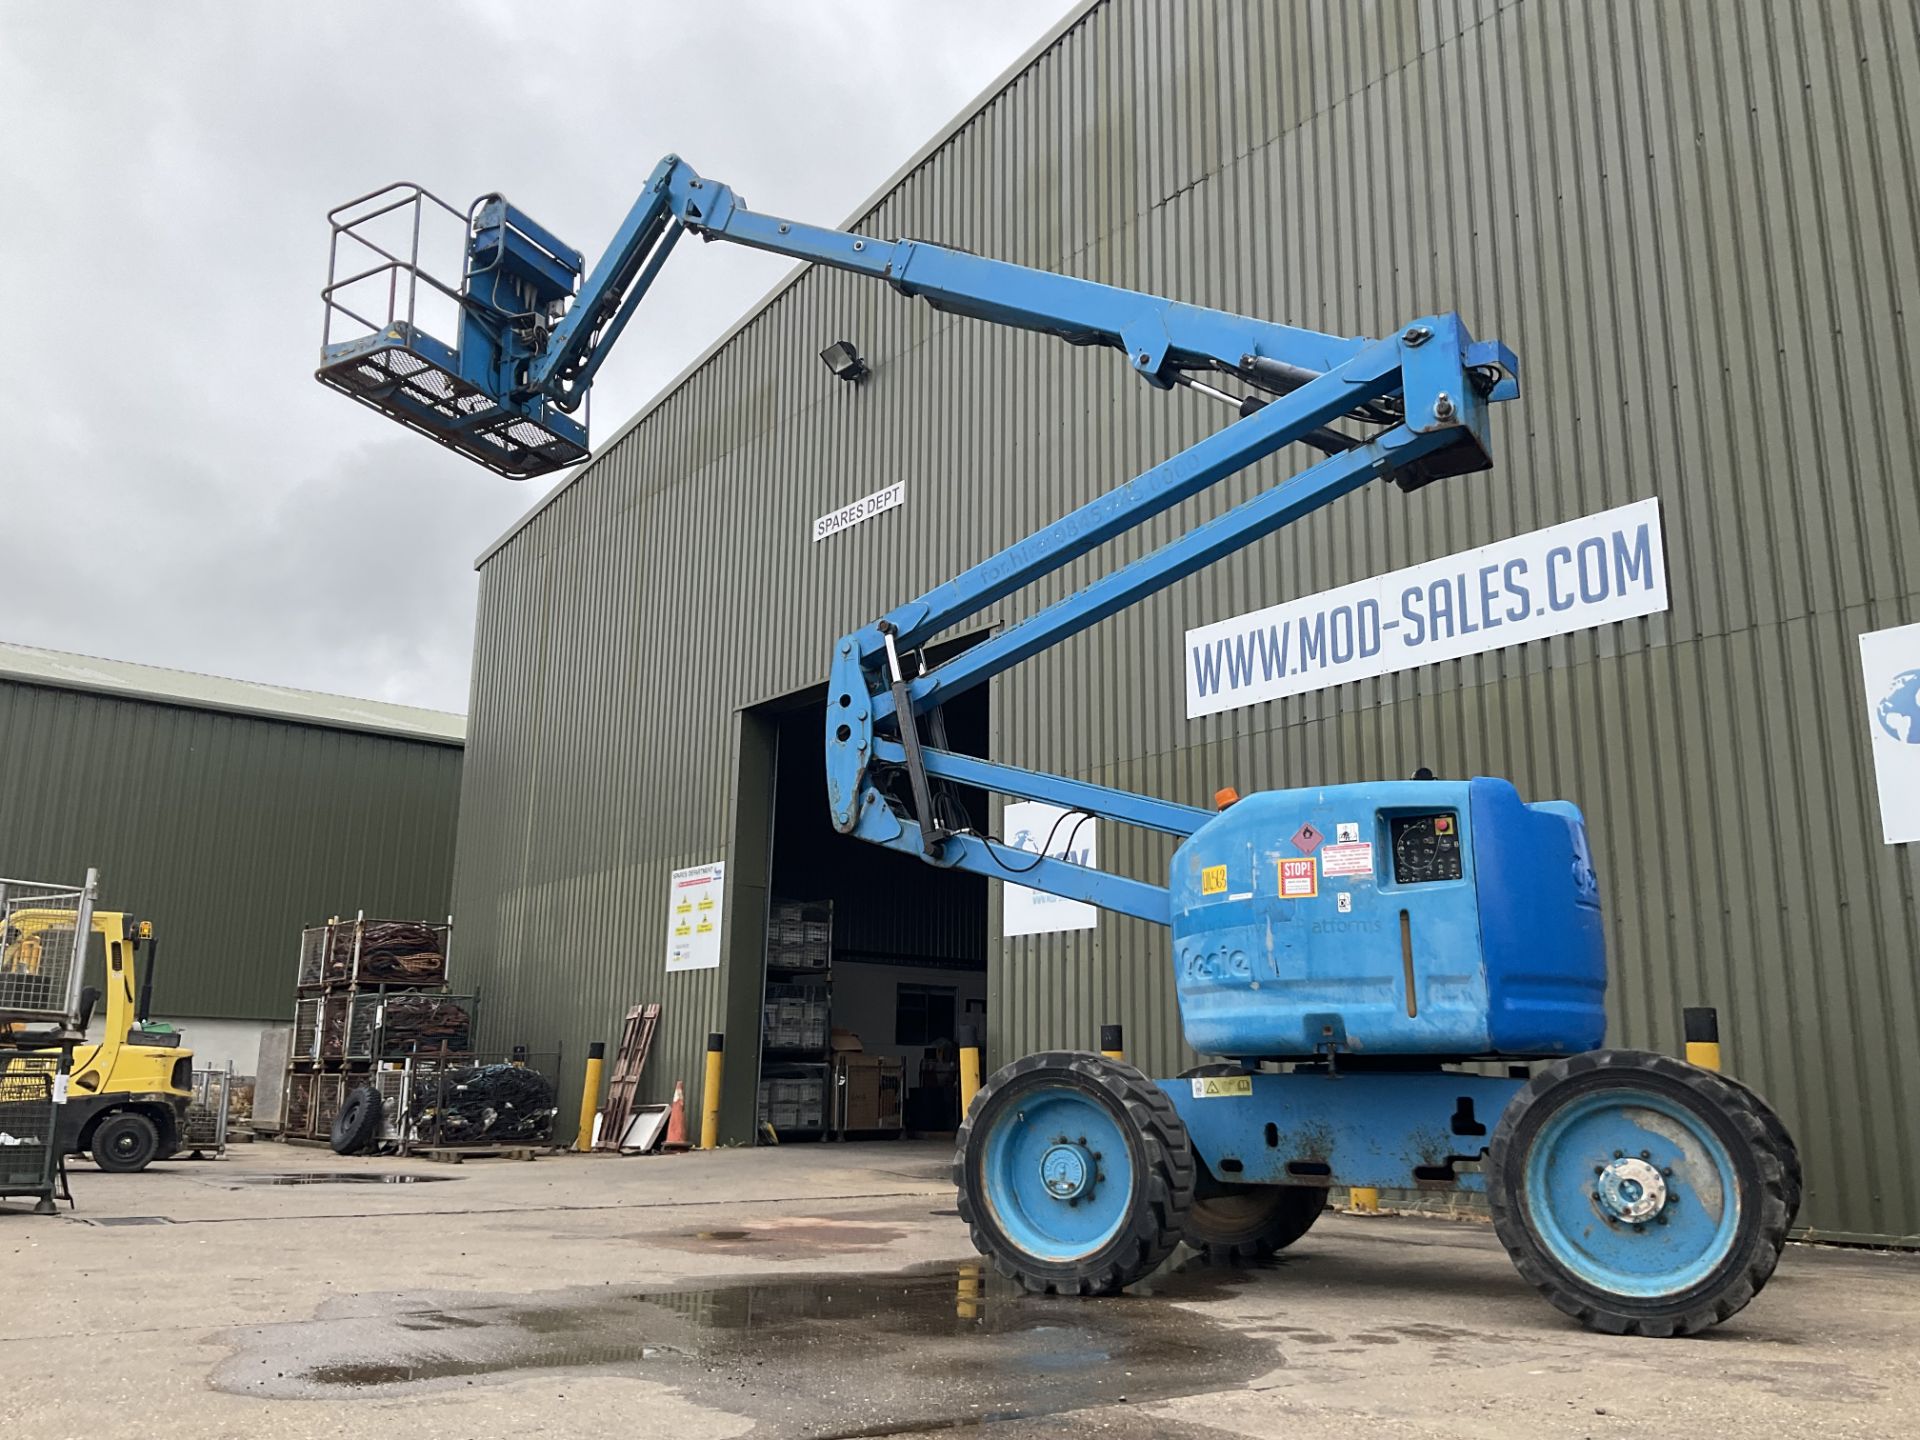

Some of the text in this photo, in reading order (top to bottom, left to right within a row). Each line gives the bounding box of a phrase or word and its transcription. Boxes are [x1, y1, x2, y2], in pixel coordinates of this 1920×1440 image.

[818, 487, 899, 535] SPARES DEPT
[1193, 524, 1653, 697] WWW.MOD-SALES.COM
[1285, 862, 1310, 876] STOP!
